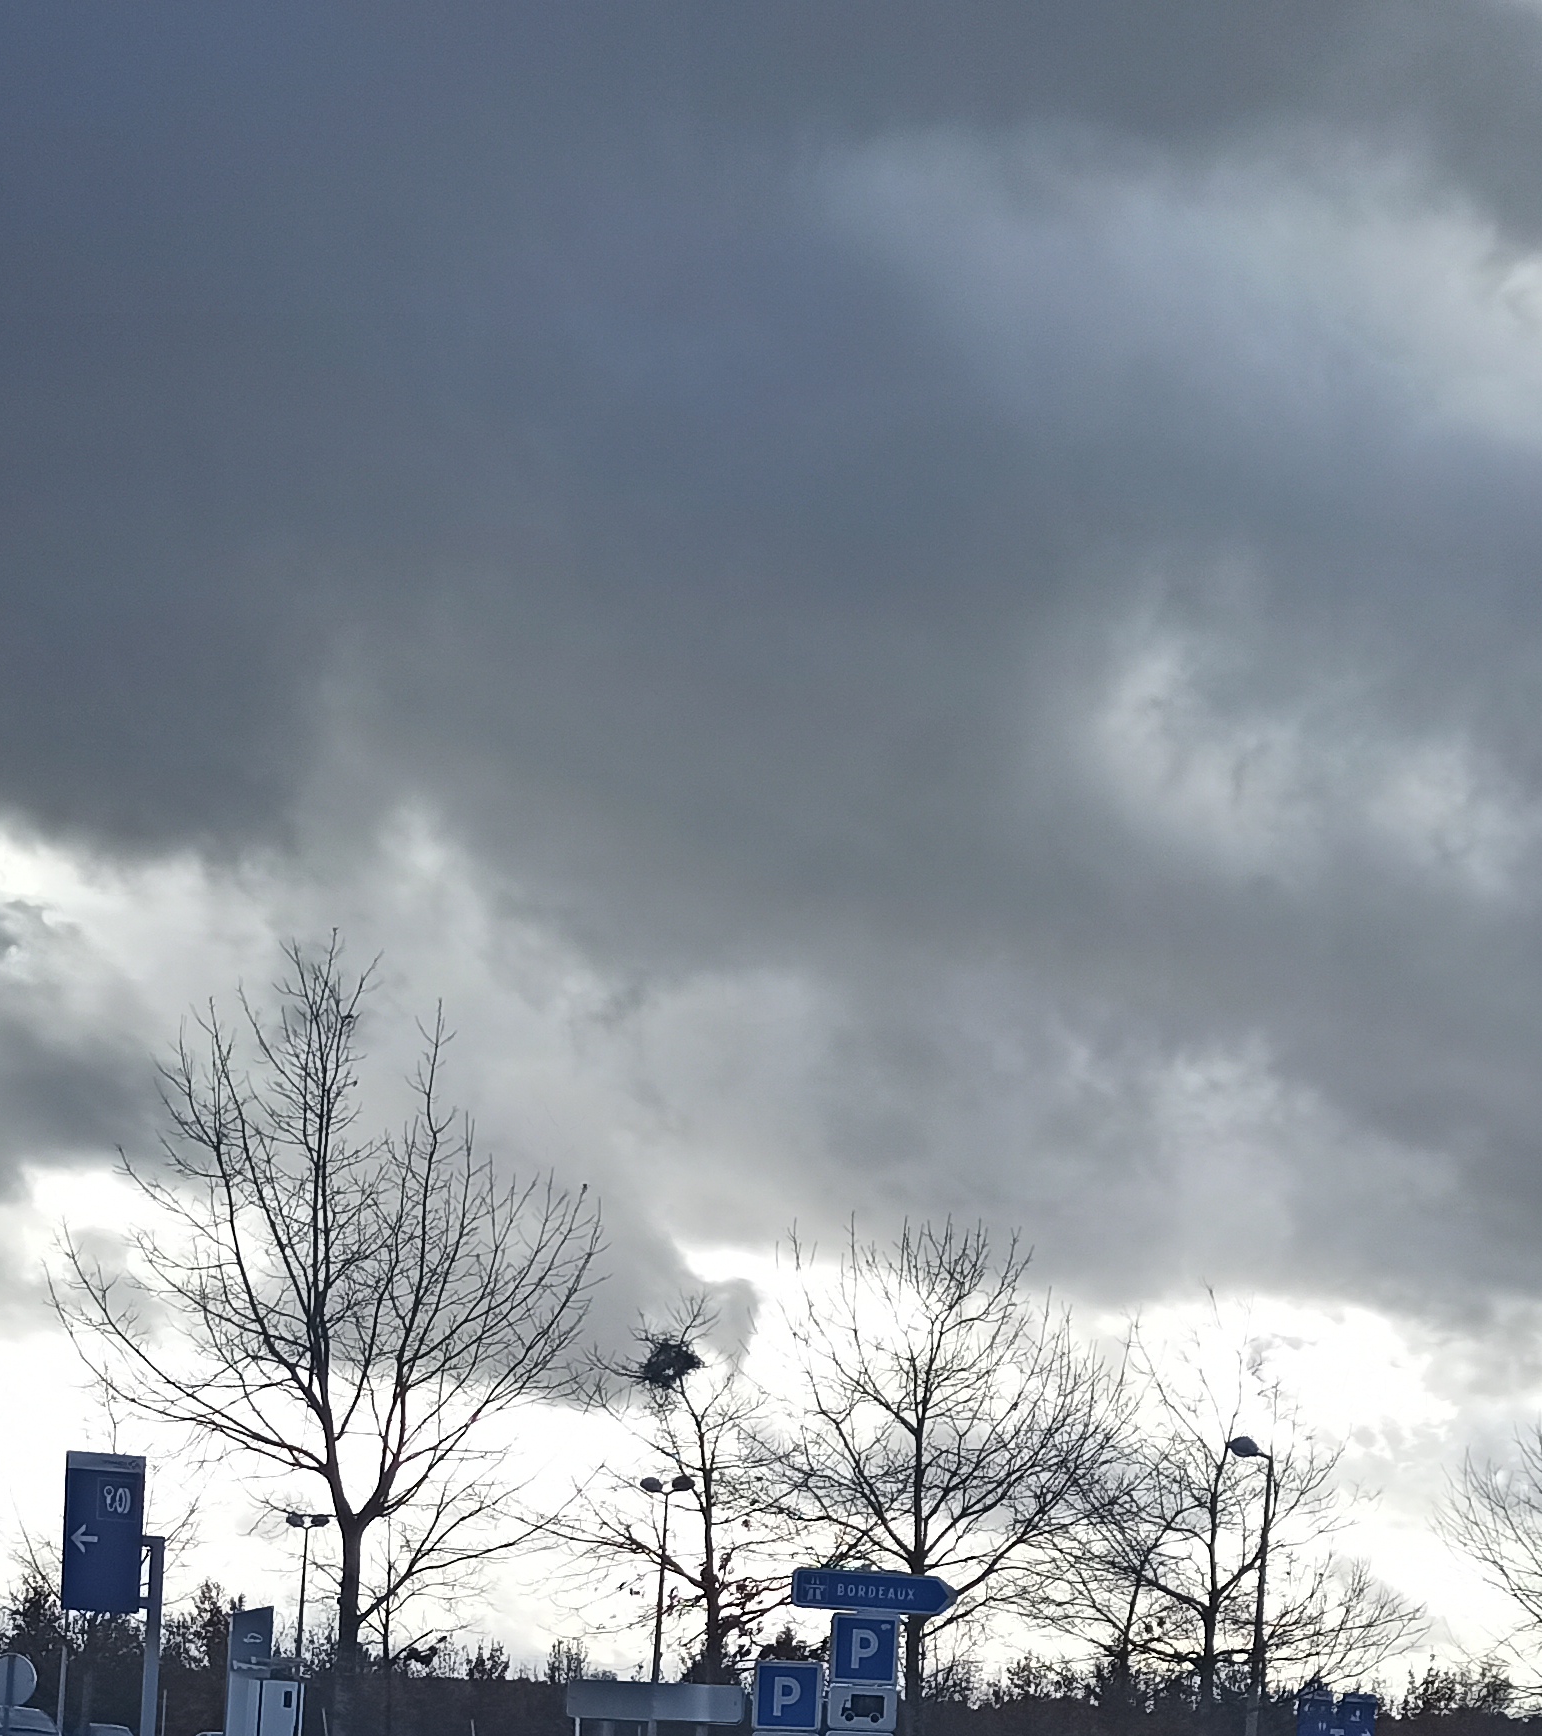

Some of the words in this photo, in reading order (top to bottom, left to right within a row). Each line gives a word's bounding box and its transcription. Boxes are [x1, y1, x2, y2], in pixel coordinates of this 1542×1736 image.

[837, 1583, 915, 1601] BORDEAUX
[850, 1628, 879, 1669] P
[772, 1676, 801, 1716] P
